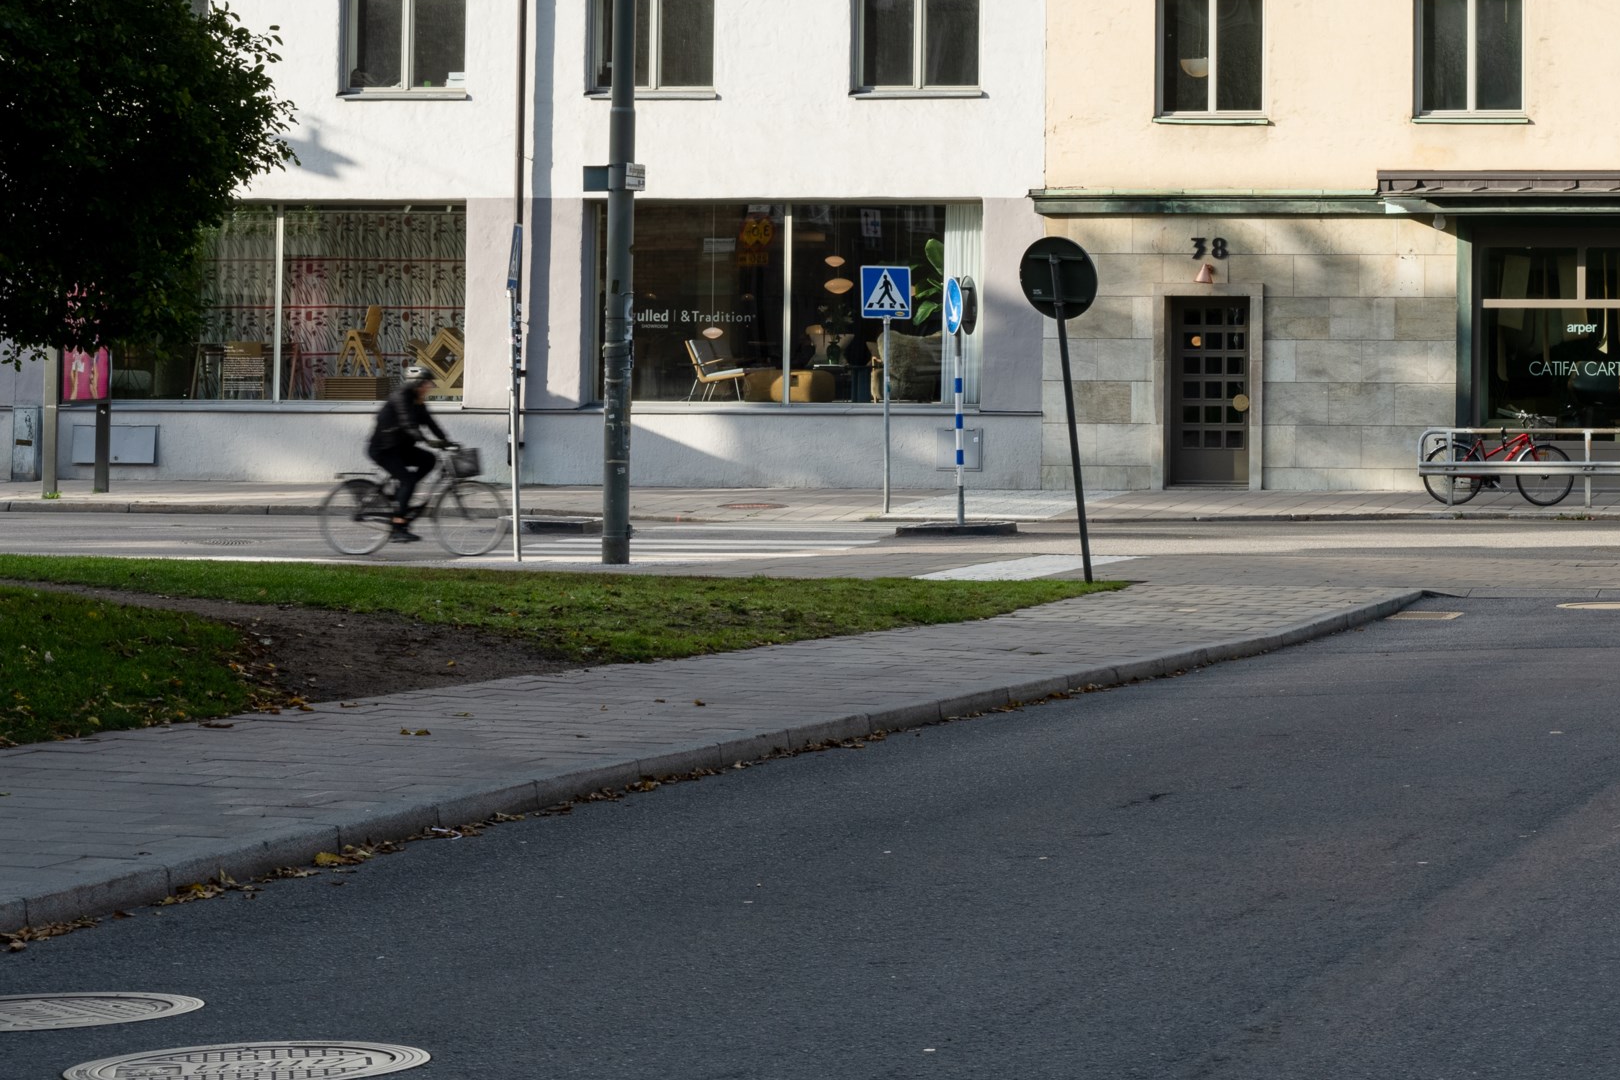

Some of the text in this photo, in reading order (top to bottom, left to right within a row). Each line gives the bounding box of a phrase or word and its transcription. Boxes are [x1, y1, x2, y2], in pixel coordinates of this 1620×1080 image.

[1190, 237, 1229, 260] 38
[1566, 323, 1598, 335] arper
[1529, 361, 1580, 376] CATIFA
